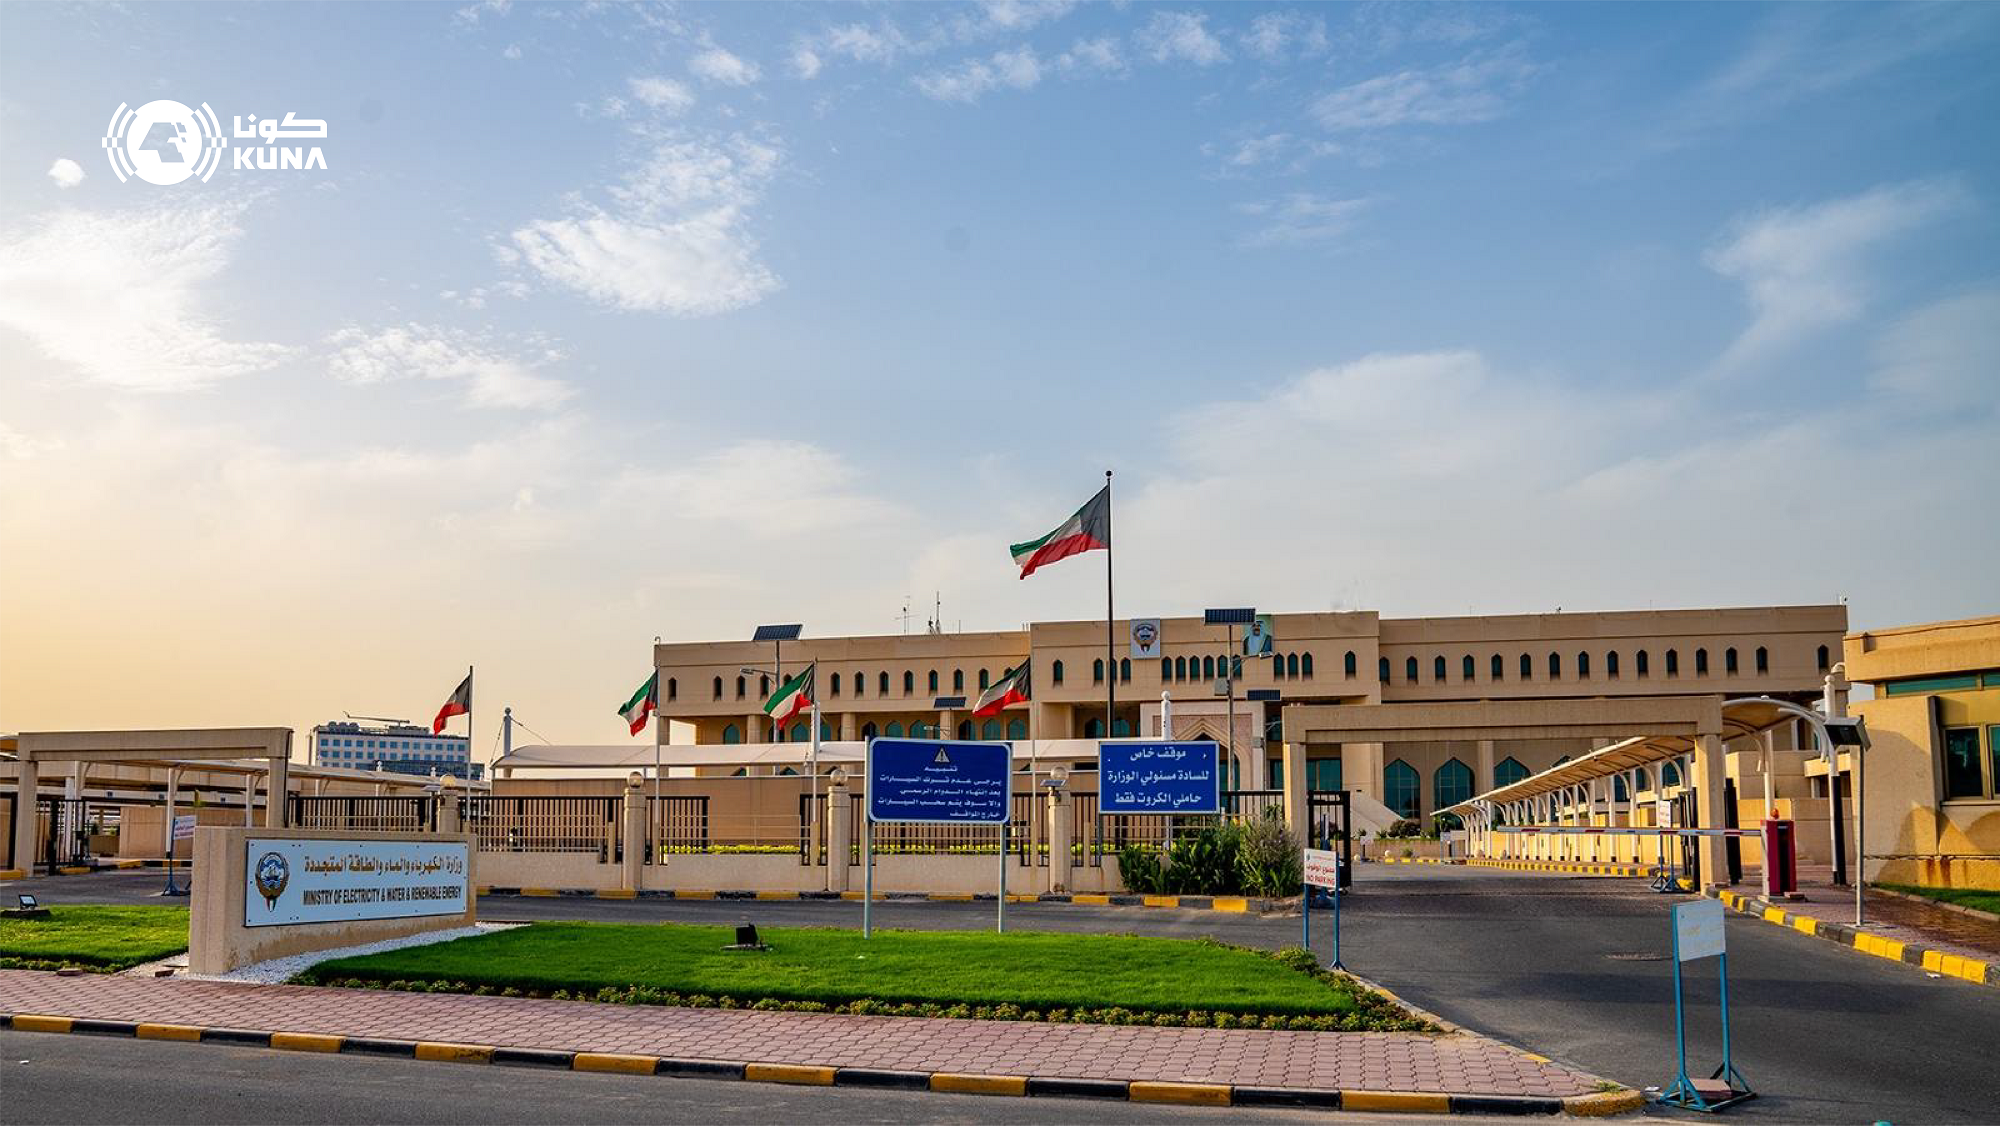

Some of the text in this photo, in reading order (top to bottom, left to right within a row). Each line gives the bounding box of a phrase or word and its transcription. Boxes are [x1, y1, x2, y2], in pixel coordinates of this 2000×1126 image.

[1130, 746, 1186, 761] موقف خاص
[880, 774, 921, 784] السيارات
[923, 776, 950, 784] ترك
[1107, 769, 1139, 783] الوزارة
[1177, 769, 1210, 780] للسادة
[878, 797, 919, 806] السيارات
[1115, 791, 1202, 808] حاملي الكروت فقط
[981, 811, 1000, 819] خارج
[304, 853, 462, 877] وزارة الكهرباء والماء والطاقة المتجددة
[303, 889, 332, 905] MINISTRY
[333, 889, 342, 904] OF
[343, 888, 380, 904] ELECTRICITY
[380, 887, 386, 902] &
[387, 887, 405, 902] WATER
[411, 886, 441, 900] RENEWABLE
[443, 885, 462, 899] ENERGY
